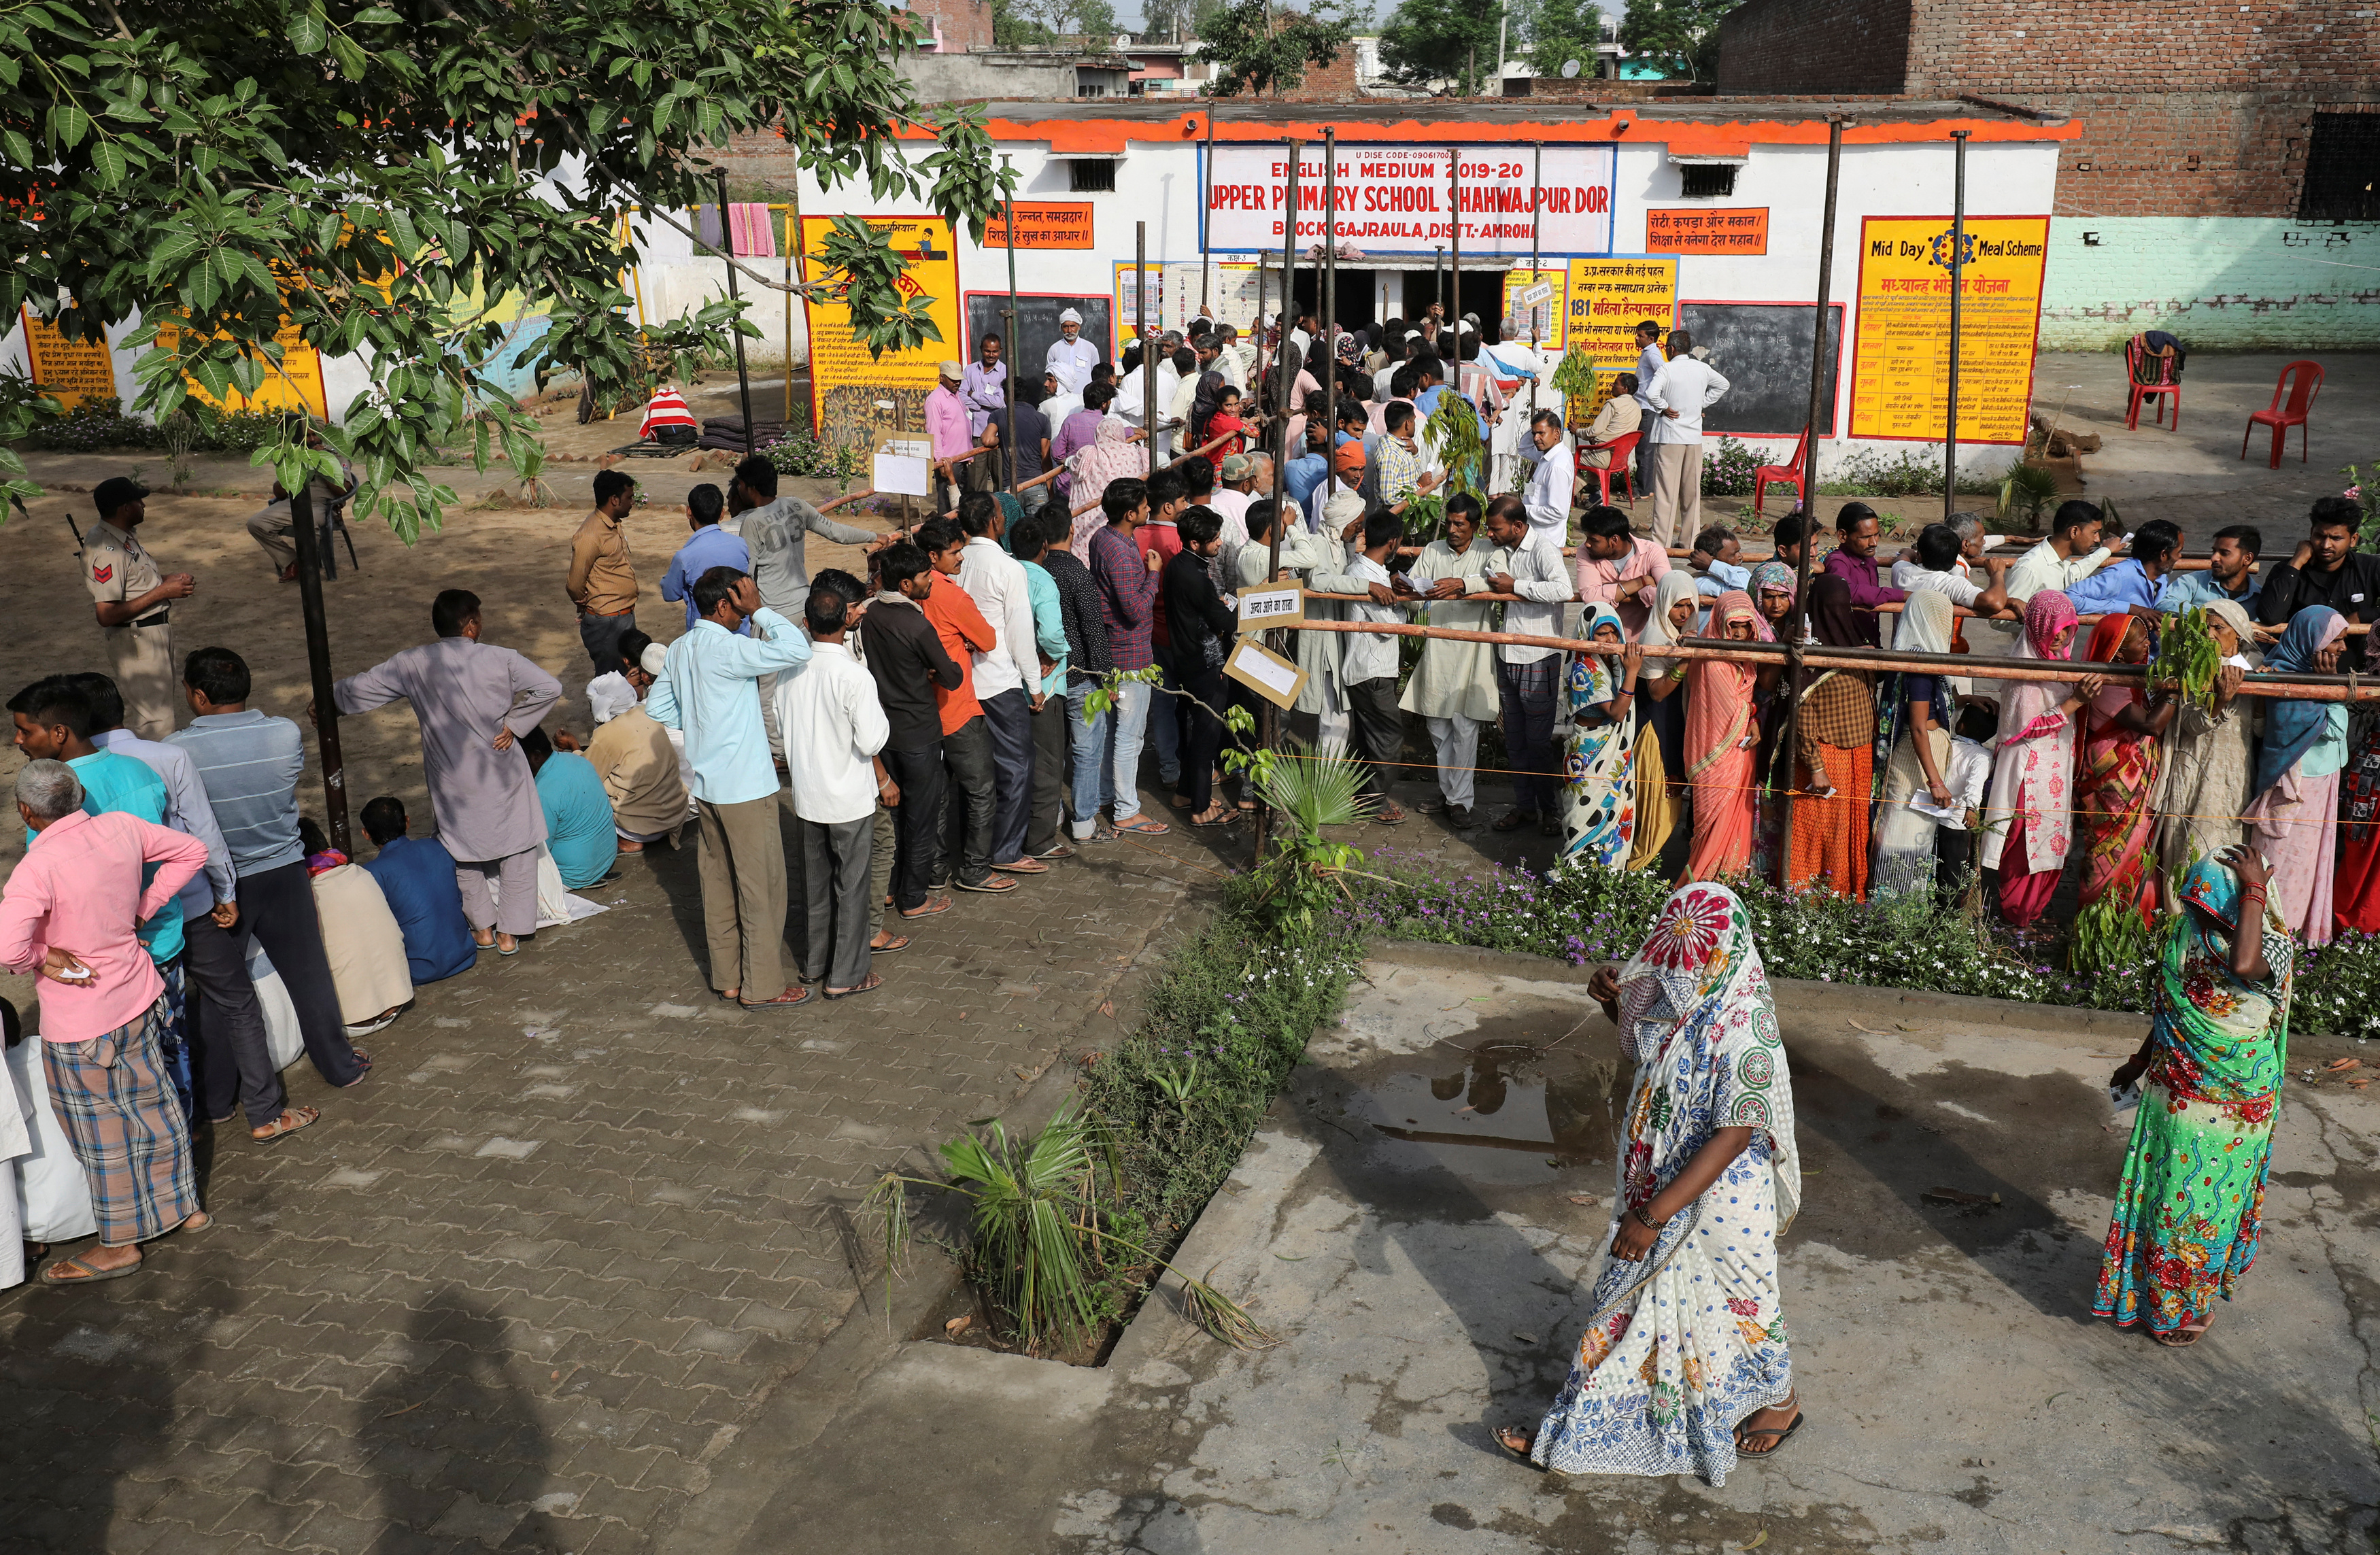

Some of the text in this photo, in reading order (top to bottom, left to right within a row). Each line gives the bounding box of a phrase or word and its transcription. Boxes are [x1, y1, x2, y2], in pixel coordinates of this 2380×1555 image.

[1361, 163, 1434, 178] MEDIUM
[1446, 163, 1523, 178] 2019-20
[1210, 185, 1266, 210] UPPER
[1365, 186, 1440, 212] SCHOOL
[1575, 186, 1608, 213] DOR
[1705, 211, 1725, 228] और
[1273, 221, 1327, 236] BOCK
[1022, 230, 1039, 245] सुख
[1040, 231, 1051, 241] का
[1650, 231, 1673, 245] शिक्षा
[1675, 231, 1683, 245] से
[1684, 231, 1710, 245] बनेगा
[1711, 230, 1727, 247] देश
[1871, 240, 2042, 261] Mid Day Meal Scheme
[1625, 264, 1633, 277] की
[1635, 264, 1646, 278] नई
[1647, 267, 1665, 278] पहल
[1614, 284, 1644, 293] समाधान
[1881, 279, 1931, 295] मध्यान्ह
[1973, 274, 2011, 294] योजना
[1571, 299, 1591, 316] 181
[1593, 297, 1622, 318] महिला
[1569, 322, 1584, 335] किसी
[1584, 322, 1592, 335] भी
[1593, 326, 1614, 335] समस्या
[1614, 326, 1622, 335] या
[53, 341, 59, 349] हो
[1581, 338, 1597, 352] महिला
[1625, 343, 1633, 352] पर
[1862, 341, 1883, 350] मंगलवार
[1612, 354, 1628, 364] विकास
[80, 367, 99, 375] अभिमान
[1855, 411, 1873, 422] शनिवार
[756, 502, 802, 531] ADIDAS
[764, 513, 806, 553] 03
[1250, 598, 1293, 614] अन्दर आने का रास्ता
